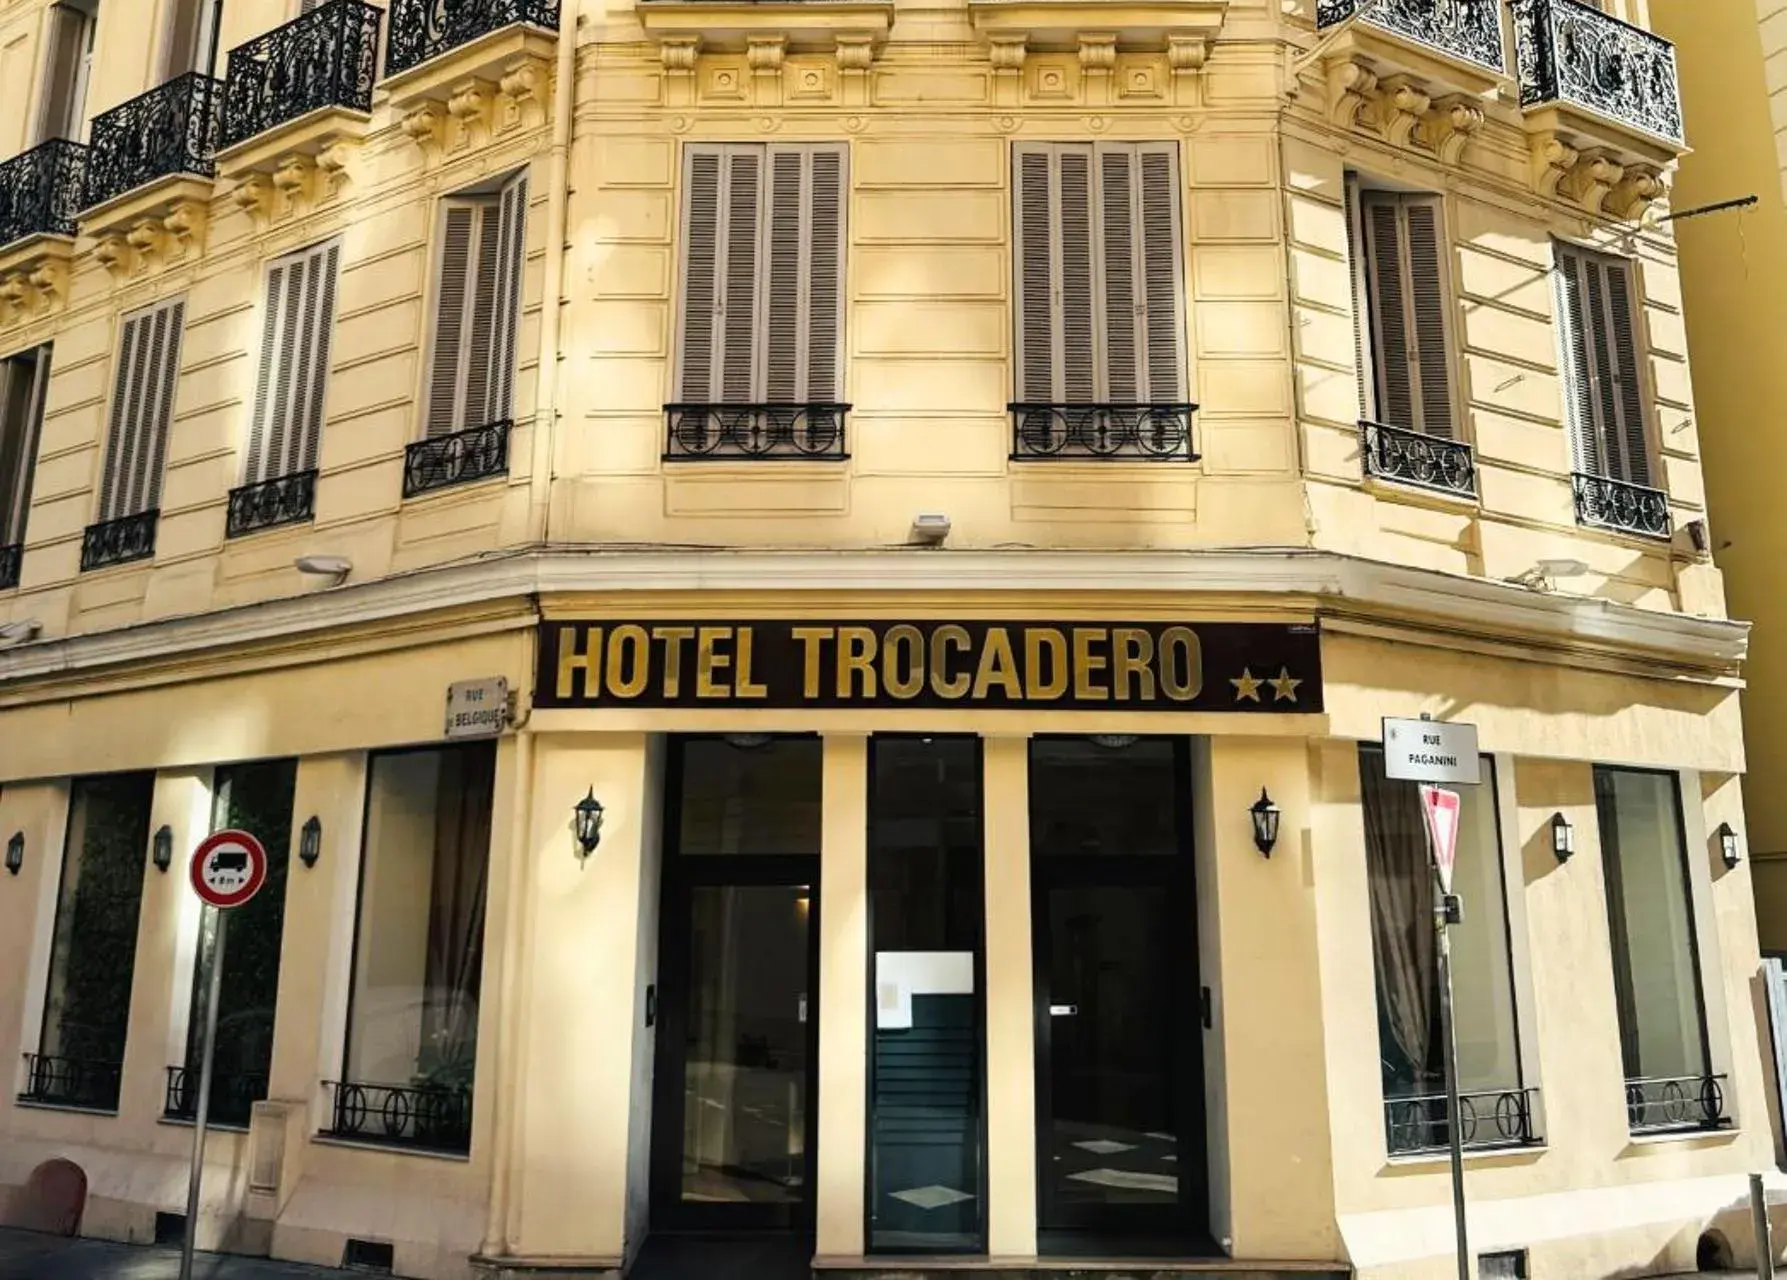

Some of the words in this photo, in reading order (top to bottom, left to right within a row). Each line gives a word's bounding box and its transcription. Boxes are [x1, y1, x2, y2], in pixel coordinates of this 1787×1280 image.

[556, 624, 767, 698] HOTEL
[792, 624, 1203, 701] TROCADERO
[465, 688, 484, 701] RUE
[455, 708, 500, 727] BELGIQUE
[1423, 734, 1441, 746] RUE
[1409, 753, 1457, 767] PAGANINI
